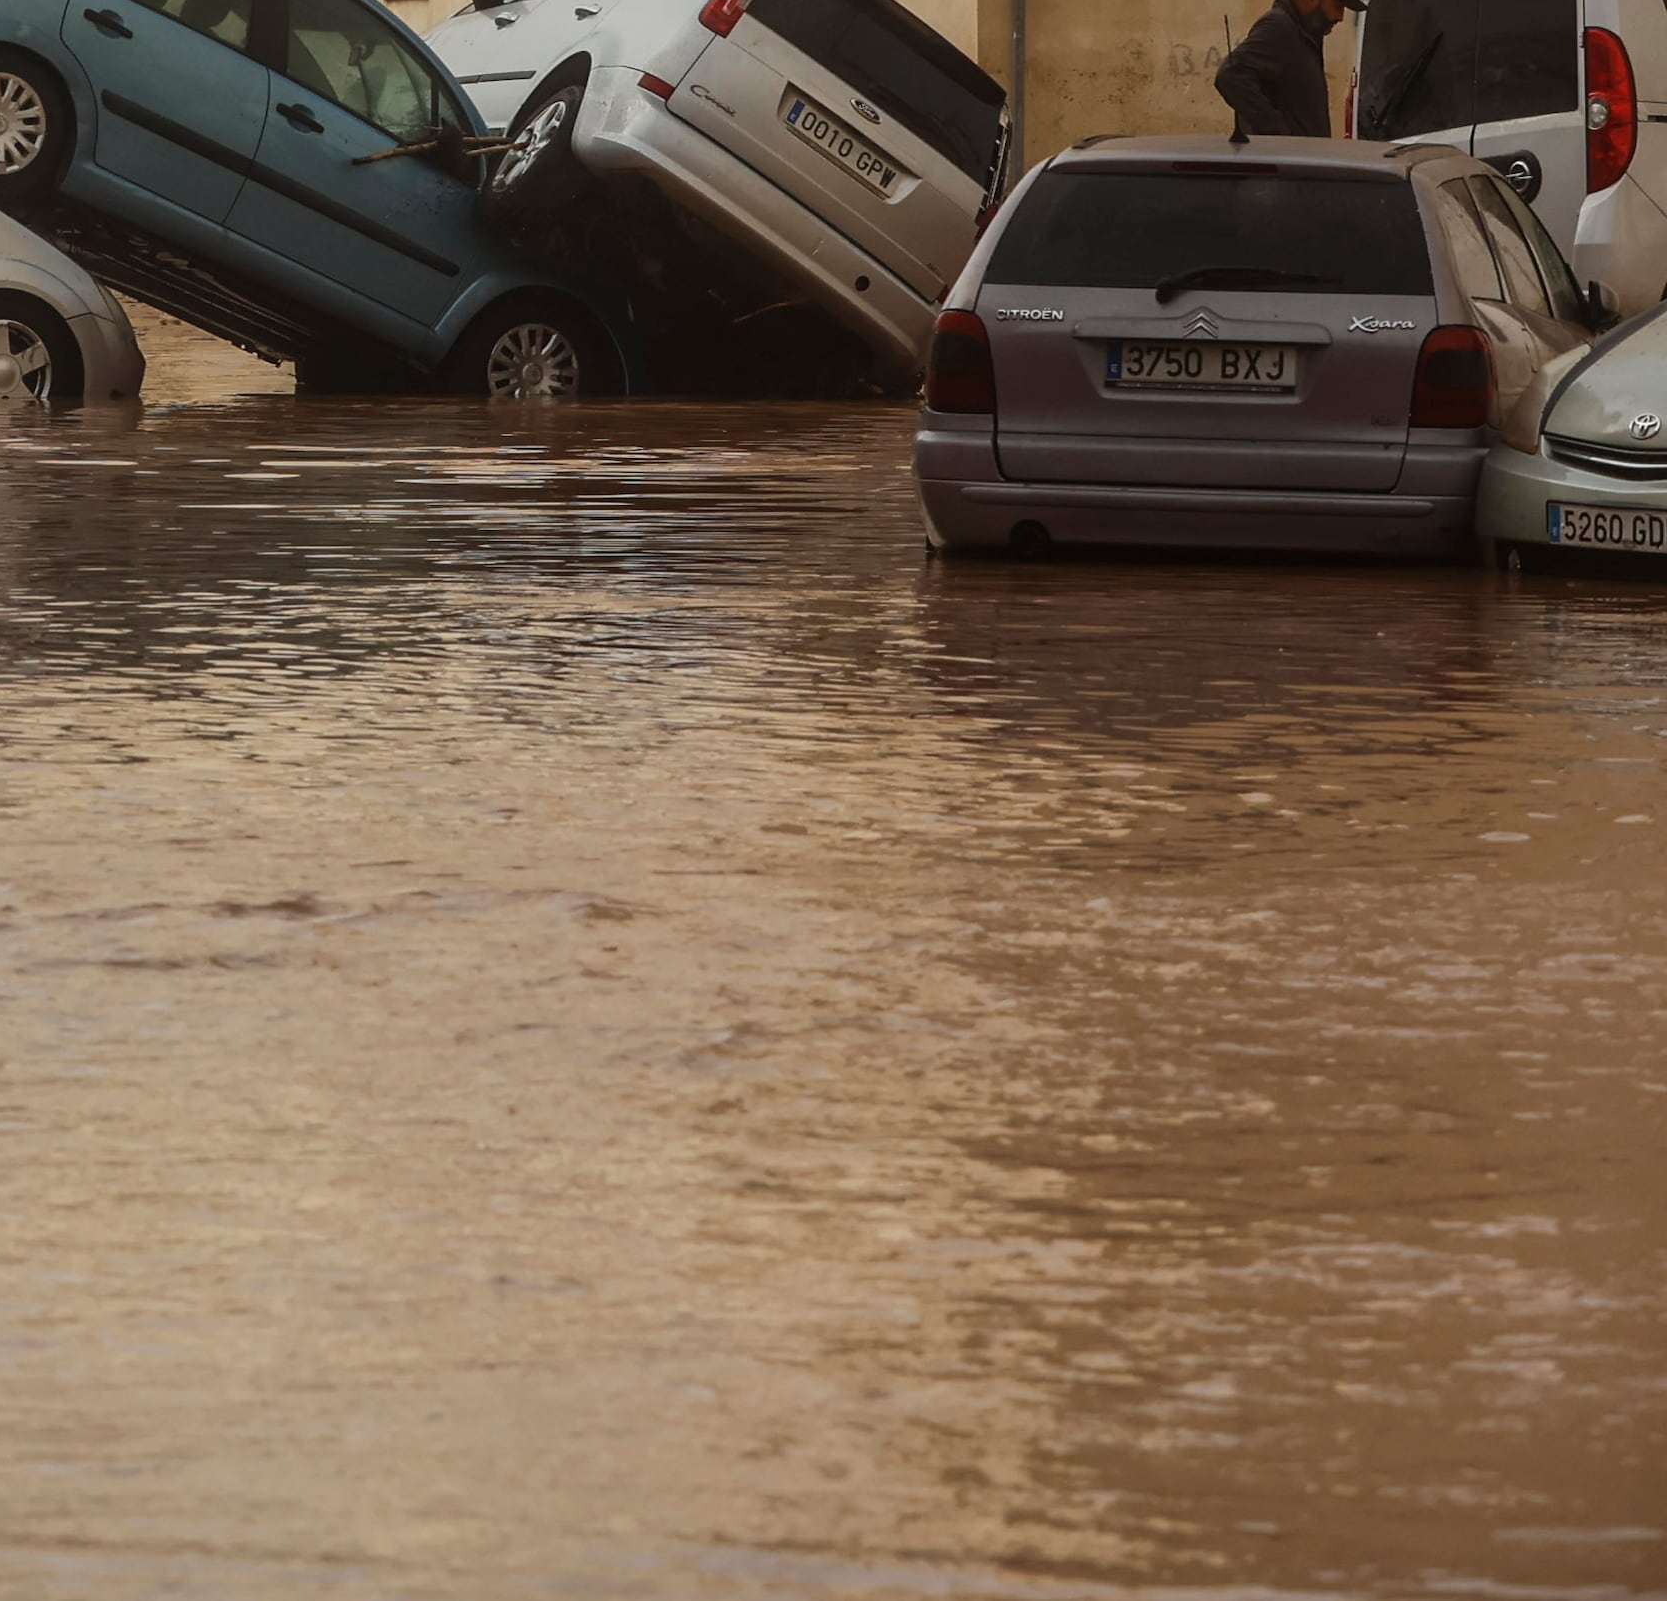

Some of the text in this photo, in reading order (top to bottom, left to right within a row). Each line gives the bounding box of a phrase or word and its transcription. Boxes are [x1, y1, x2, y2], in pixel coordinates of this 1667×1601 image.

[801, 111, 897, 189] 0010 GPW
[996, 307, 1064, 321] CITROËN
[1348, 315, 1417, 332] Xsara
[1125, 347, 1204, 378] 3750
[1220, 349, 1285, 381] BXJ
[1563, 509, 1624, 544] 5260
